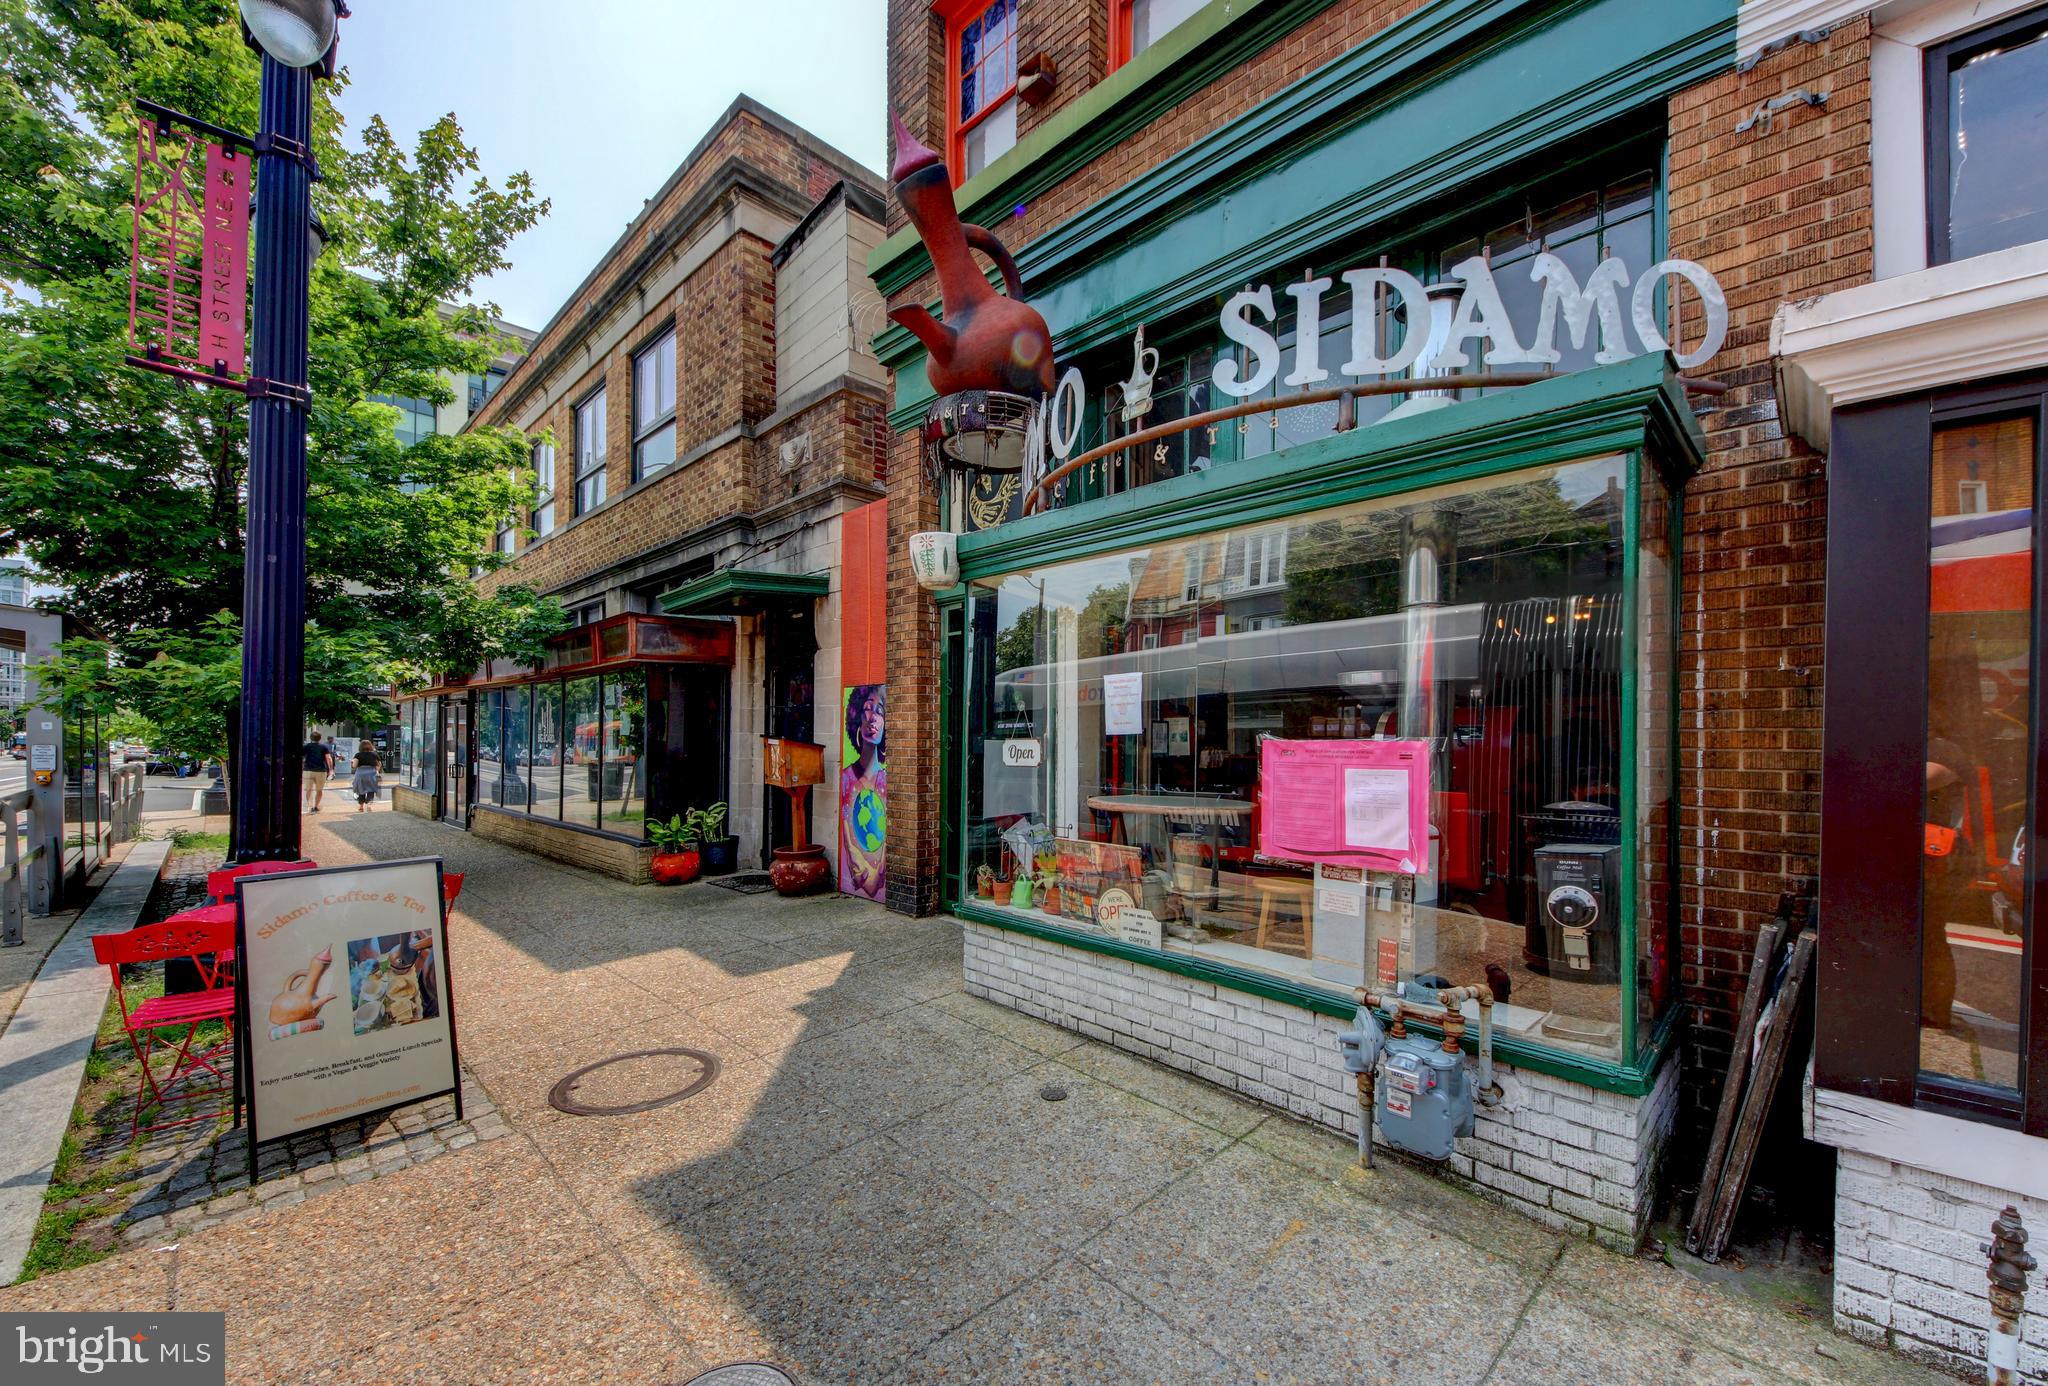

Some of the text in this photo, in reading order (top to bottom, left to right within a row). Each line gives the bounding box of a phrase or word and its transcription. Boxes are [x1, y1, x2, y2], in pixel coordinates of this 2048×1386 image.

[212, 240, 232, 323] STREET
[211, 334, 228, 350] H
[1212, 252, 1729, 398] SIDAMO
[1154, 444, 1170, 464] &
[1206, 416, 1279, 446] Tea
[1008, 744, 1035, 763] Open
[256, 890, 427, 940] Sidamo Coffee & Tea
[1128, 936, 1151, 946] COFFEE
[260, 1077, 280, 1087] Enjoy
[376, 1047, 402, 1058] Gourmet
[402, 1042, 421, 1052] Lunch
[421, 1037, 443, 1048] Specials
[313, 1072, 327, 1081] with
[333, 1067, 351, 1079] Vegan
[359, 1060, 379, 1073] Veggie
[380, 1055, 401, 1066] Variety
[294, 1083, 422, 1124] www.sidamocoffeeandtea.com
